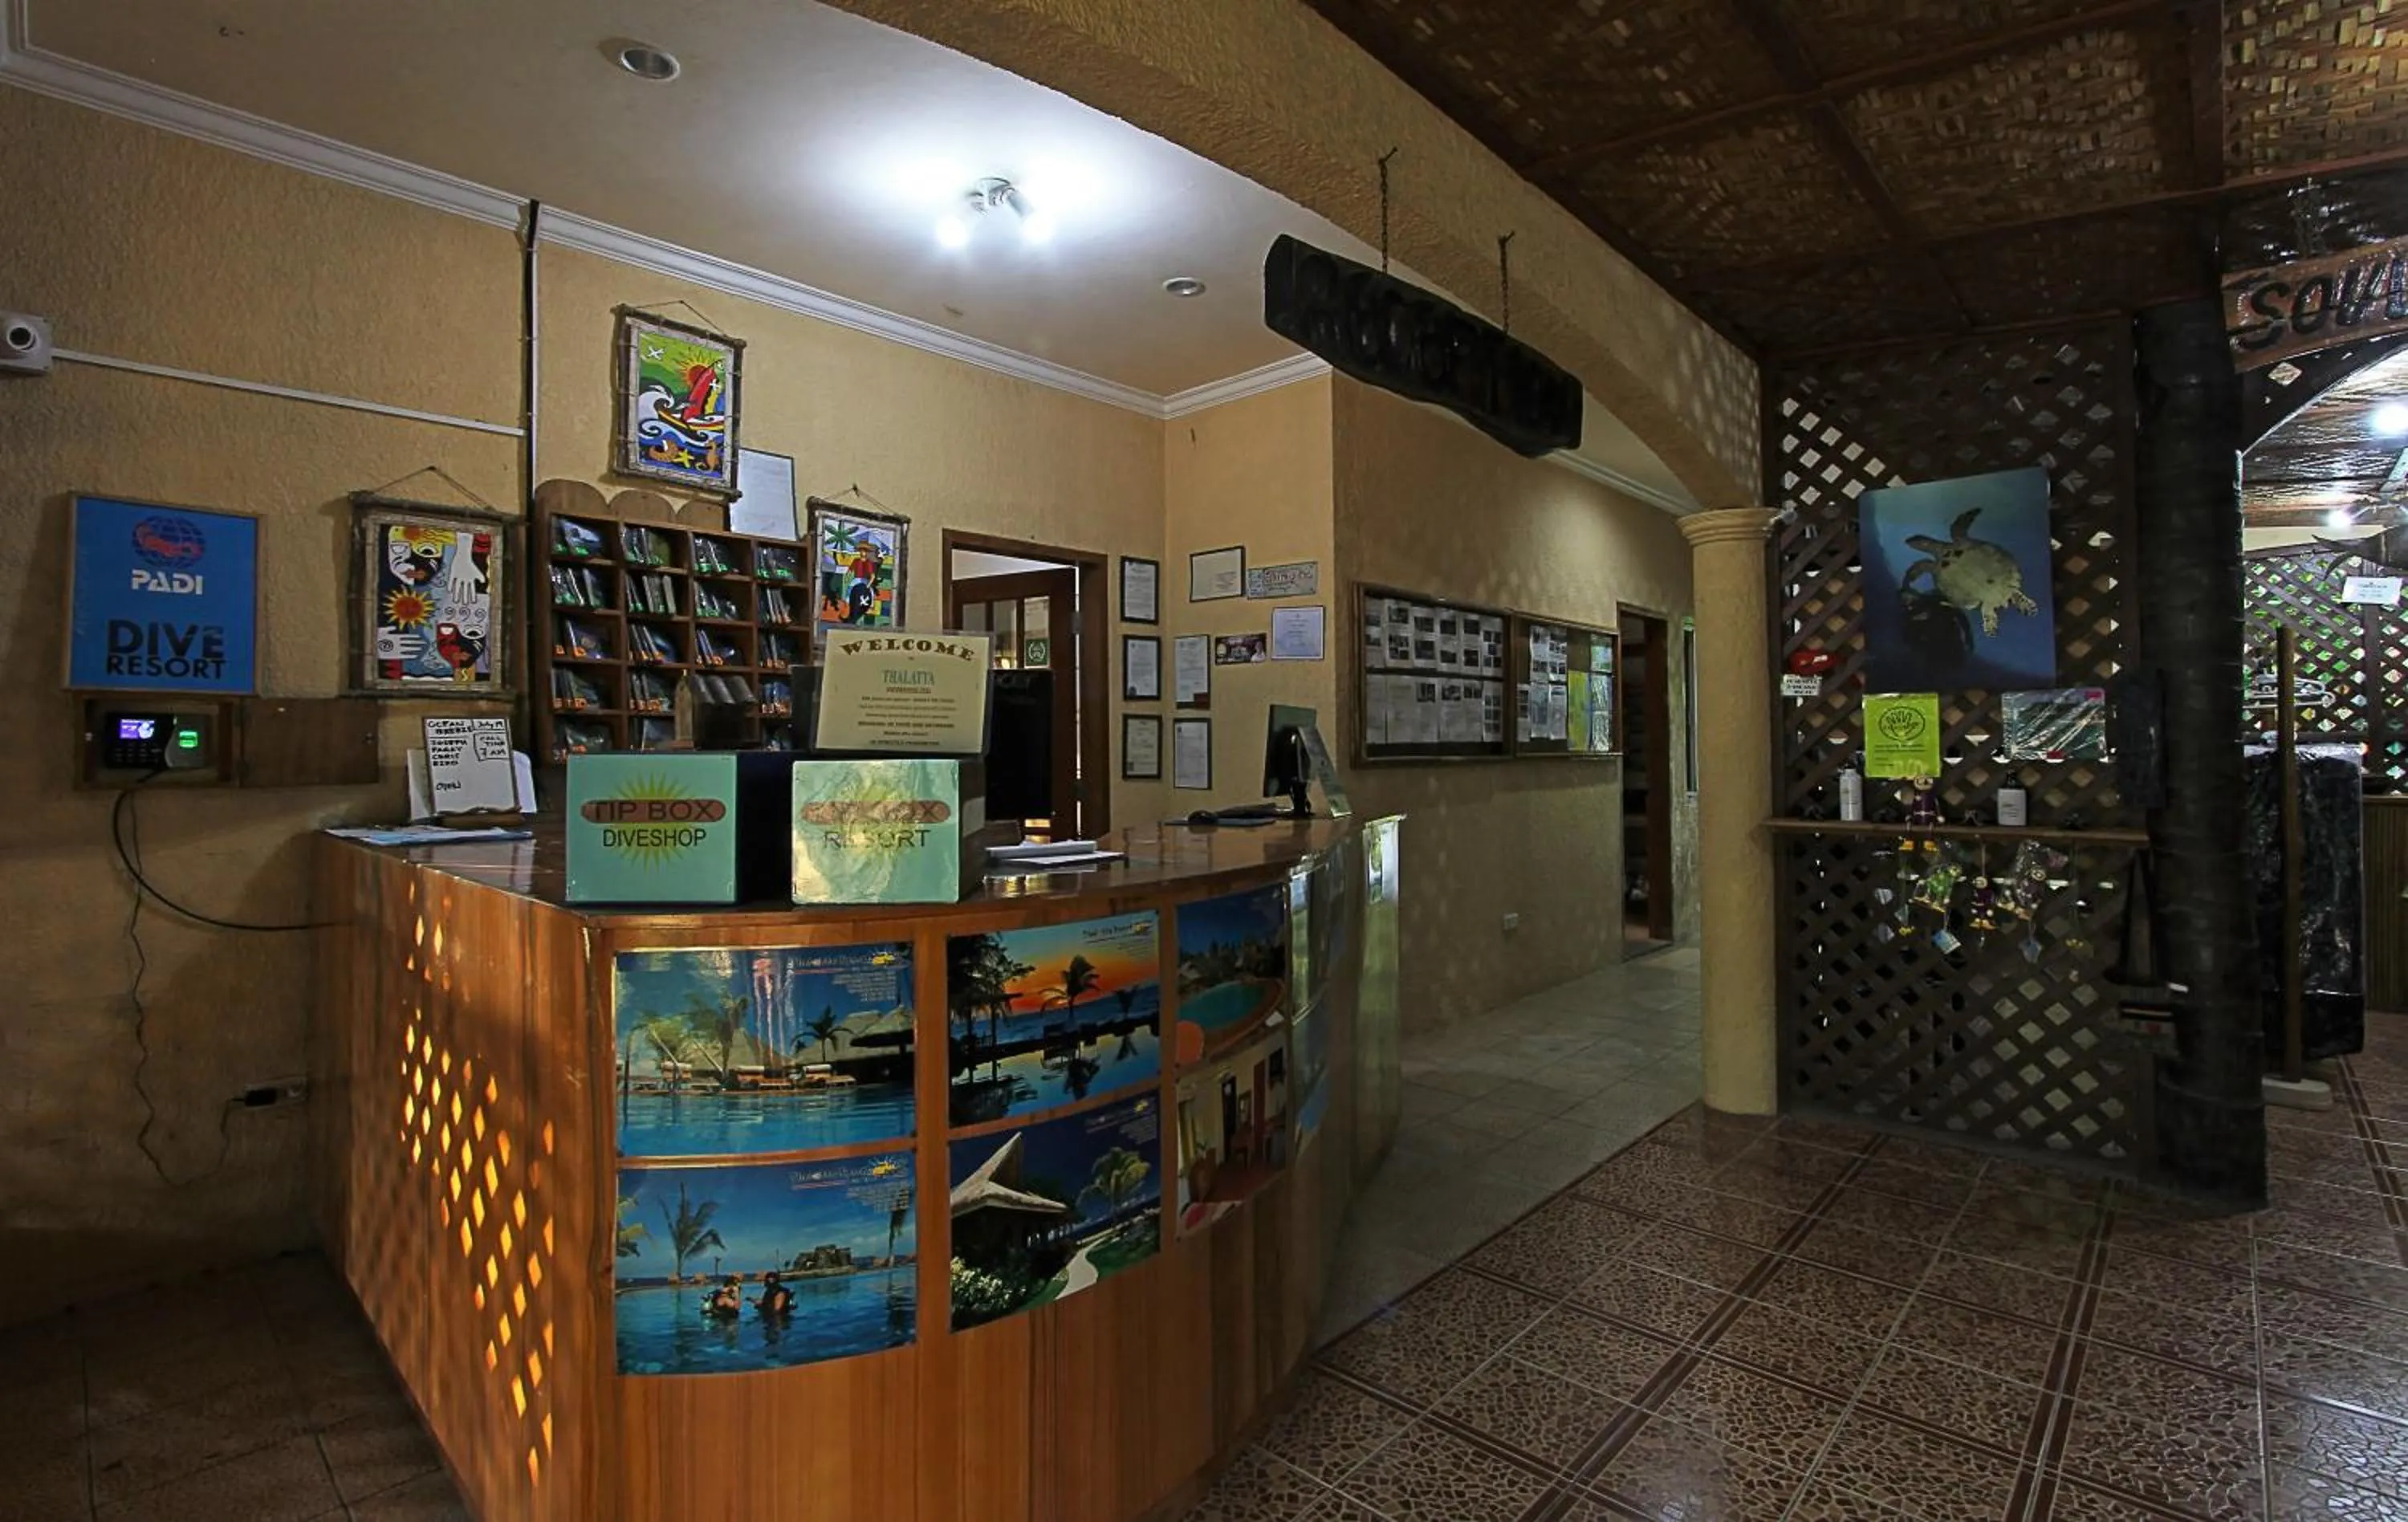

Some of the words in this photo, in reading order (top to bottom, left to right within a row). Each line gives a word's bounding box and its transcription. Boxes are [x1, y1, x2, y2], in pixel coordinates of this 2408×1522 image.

[131, 568, 203, 595] PADI
[108, 619, 225, 658] DIVE
[839, 637, 974, 661] WELCOME
[106, 654, 227, 679] RESORT
[592, 804, 637, 823] TIP
[648, 804, 714, 823] BOX
[603, 828, 707, 848] DIVESHOP
